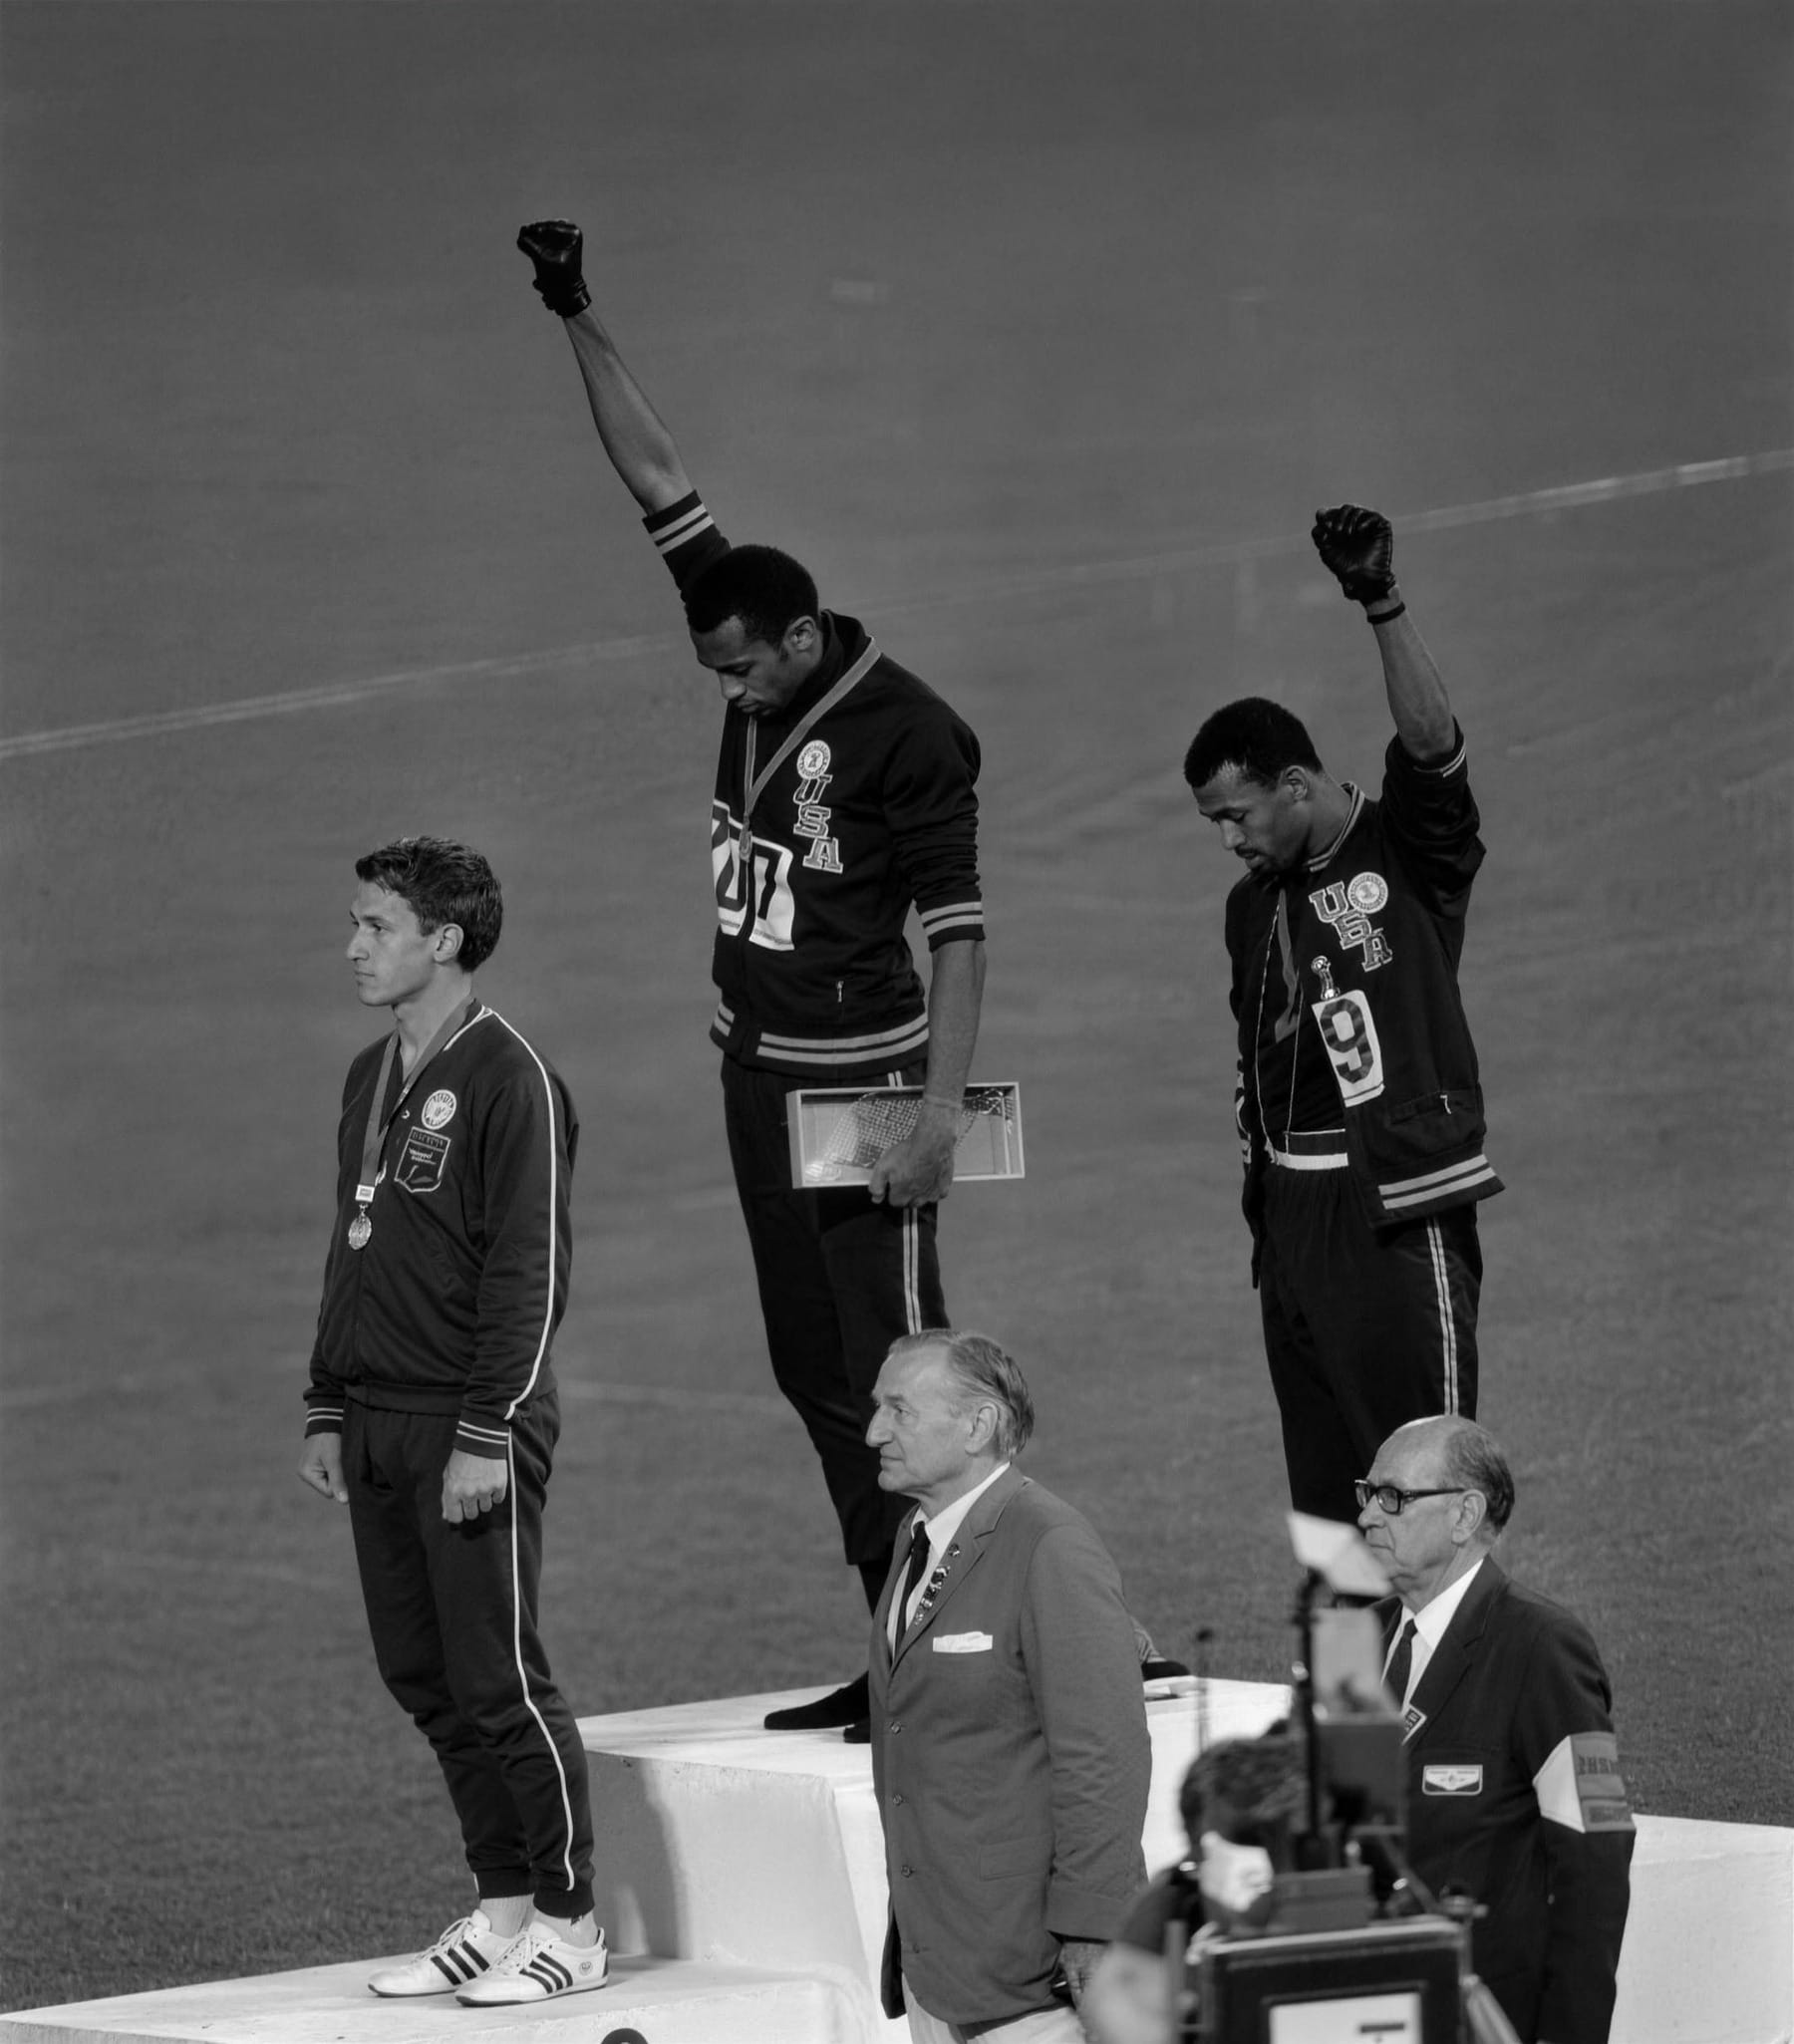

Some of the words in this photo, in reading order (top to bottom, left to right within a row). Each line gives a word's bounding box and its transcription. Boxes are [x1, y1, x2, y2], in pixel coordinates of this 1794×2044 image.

[793, 774, 843, 874] USA
[1309, 881, 1392, 972] USA
[1320, 999, 1374, 1084] 9
